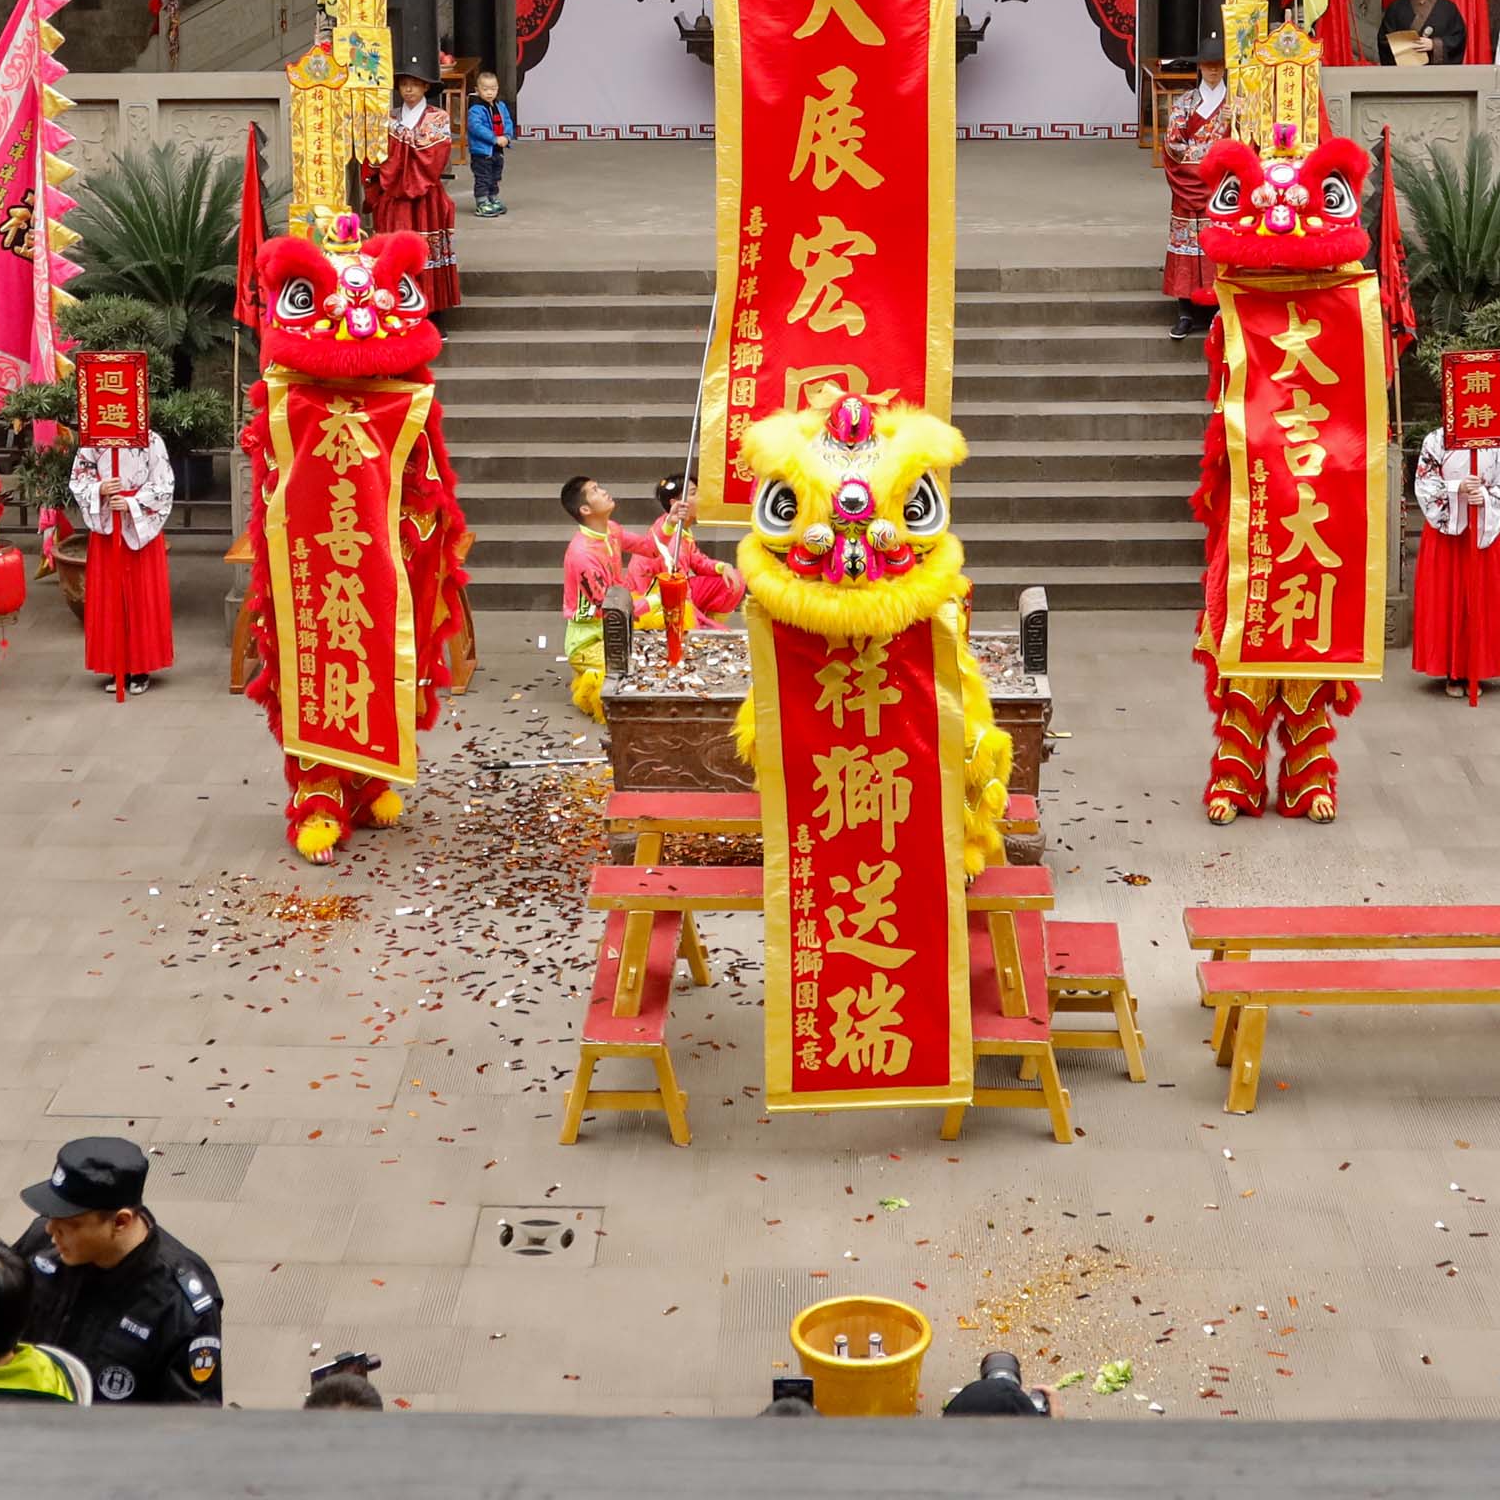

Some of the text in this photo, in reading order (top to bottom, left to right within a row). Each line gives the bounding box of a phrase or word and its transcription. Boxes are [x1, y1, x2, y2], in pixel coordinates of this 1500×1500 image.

[95, 370, 132, 429] 迴避
[1267, 301, 1344, 654] 大吉大利
[1461, 369, 1498, 429] 肅靜
[311, 396, 380, 746] 恭喜發財
[790, 824, 824, 1071] 喜洋洋龍獅團致意
[811, 632, 916, 1077] 祥獅送瑞
